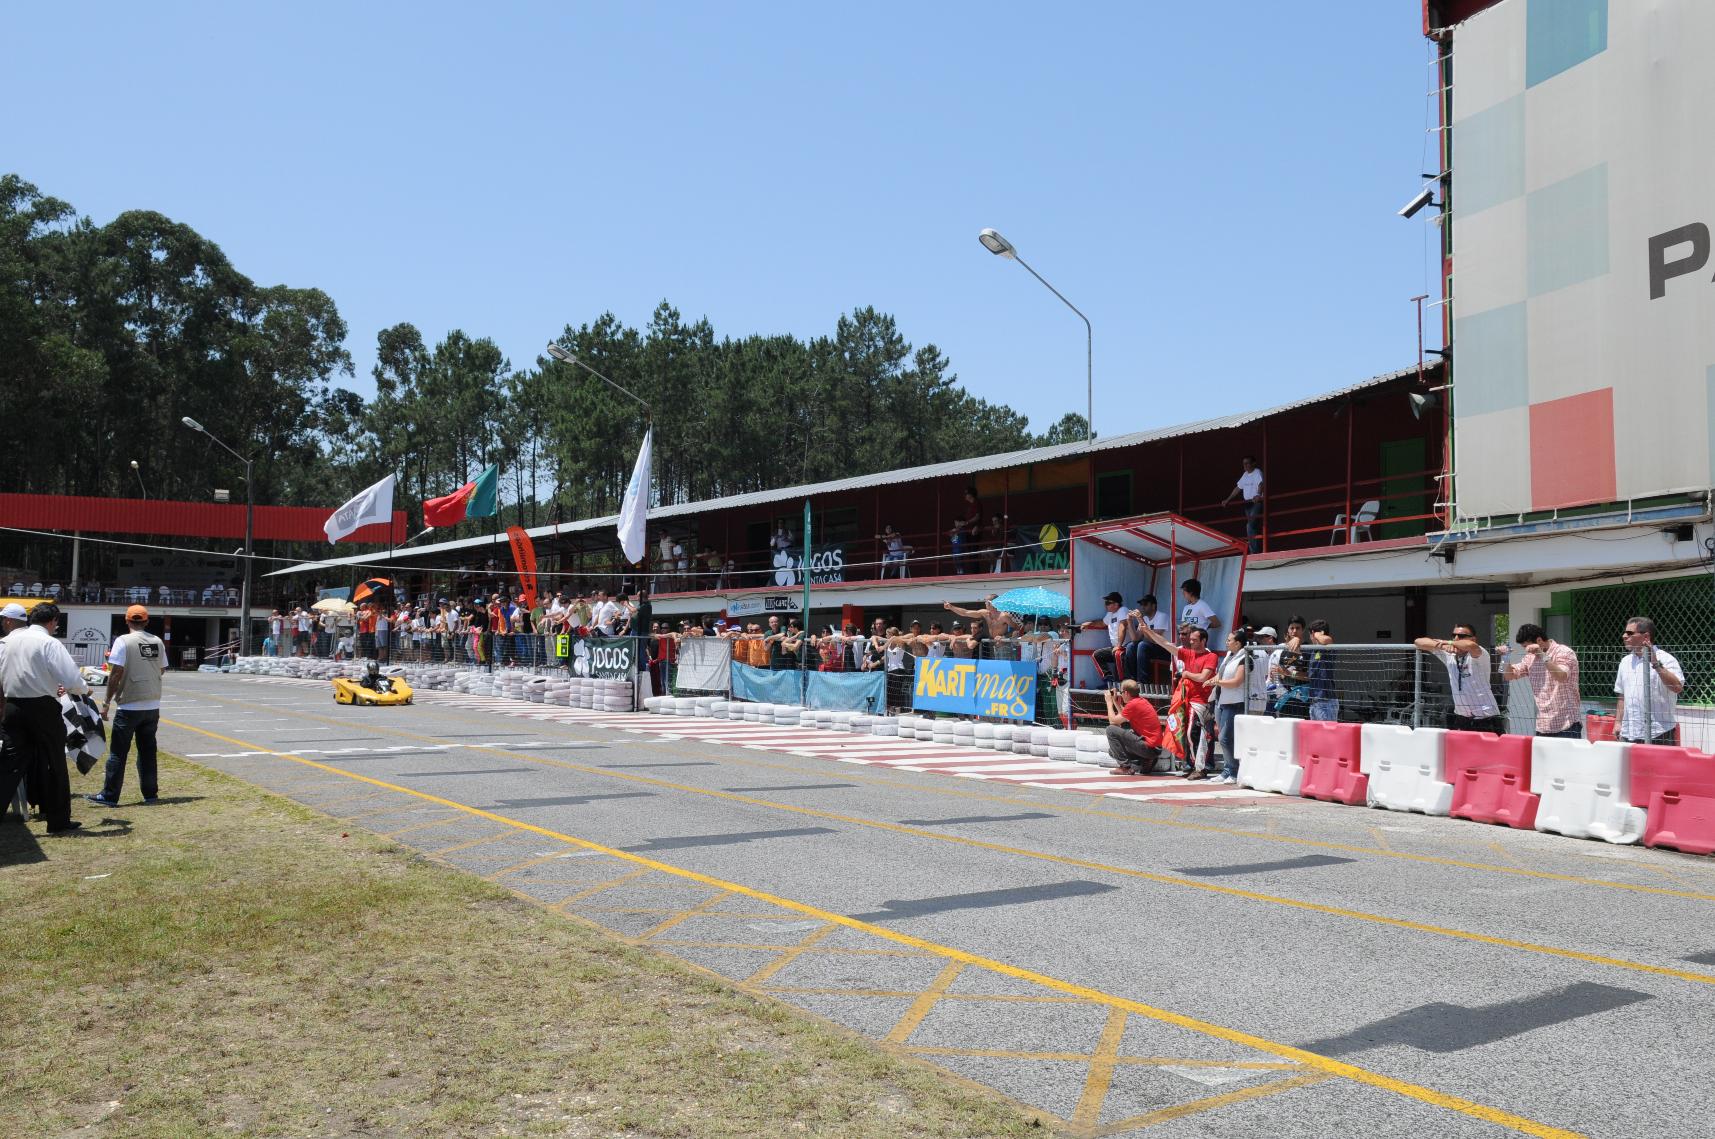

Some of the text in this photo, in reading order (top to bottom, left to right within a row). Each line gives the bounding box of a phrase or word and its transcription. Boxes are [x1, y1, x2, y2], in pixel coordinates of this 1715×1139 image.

[1648, 222, 1715, 300] P
[1021, 551, 1071, 571] AKEN
[974, 672, 1034, 717] mag
